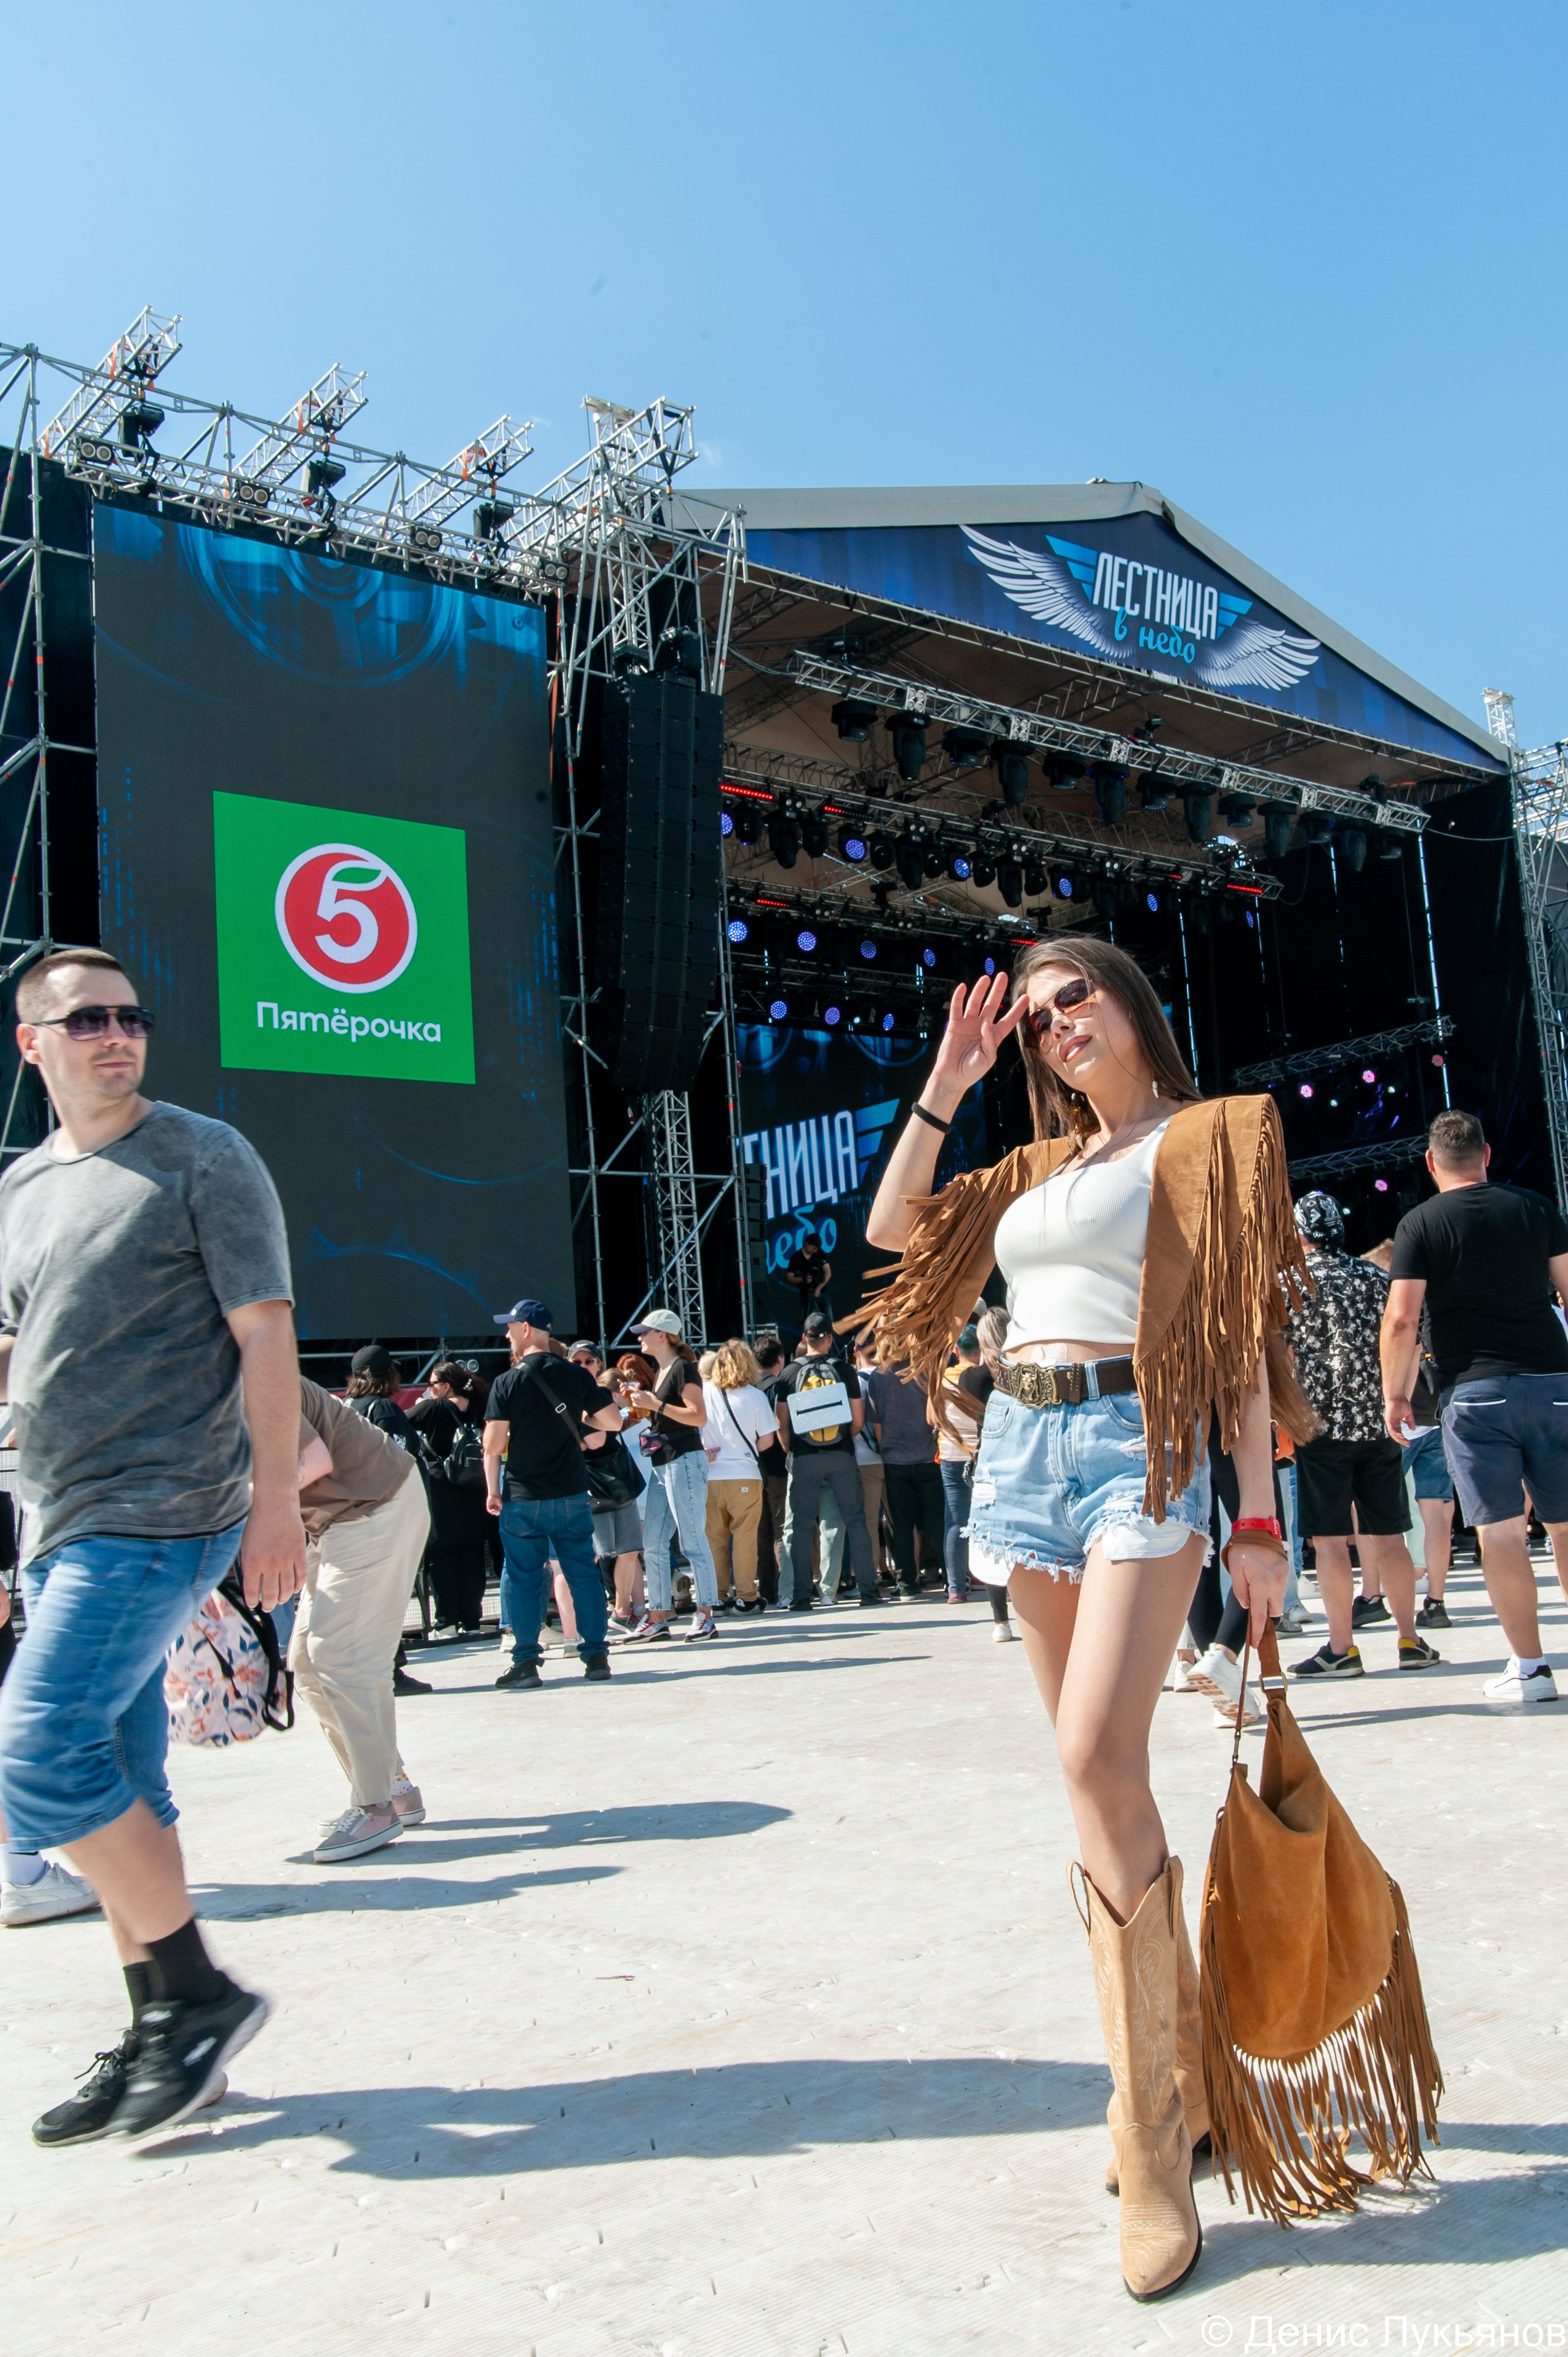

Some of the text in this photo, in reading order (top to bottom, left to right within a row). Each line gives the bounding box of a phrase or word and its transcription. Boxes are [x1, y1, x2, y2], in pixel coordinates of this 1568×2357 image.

[1093, 552, 1218, 641] ЛЕСТНИЦА
[1113, 605, 1196, 664] в небо
[315, 860, 382, 964] 5
[257, 1001, 442, 1042] Пятёрочка
